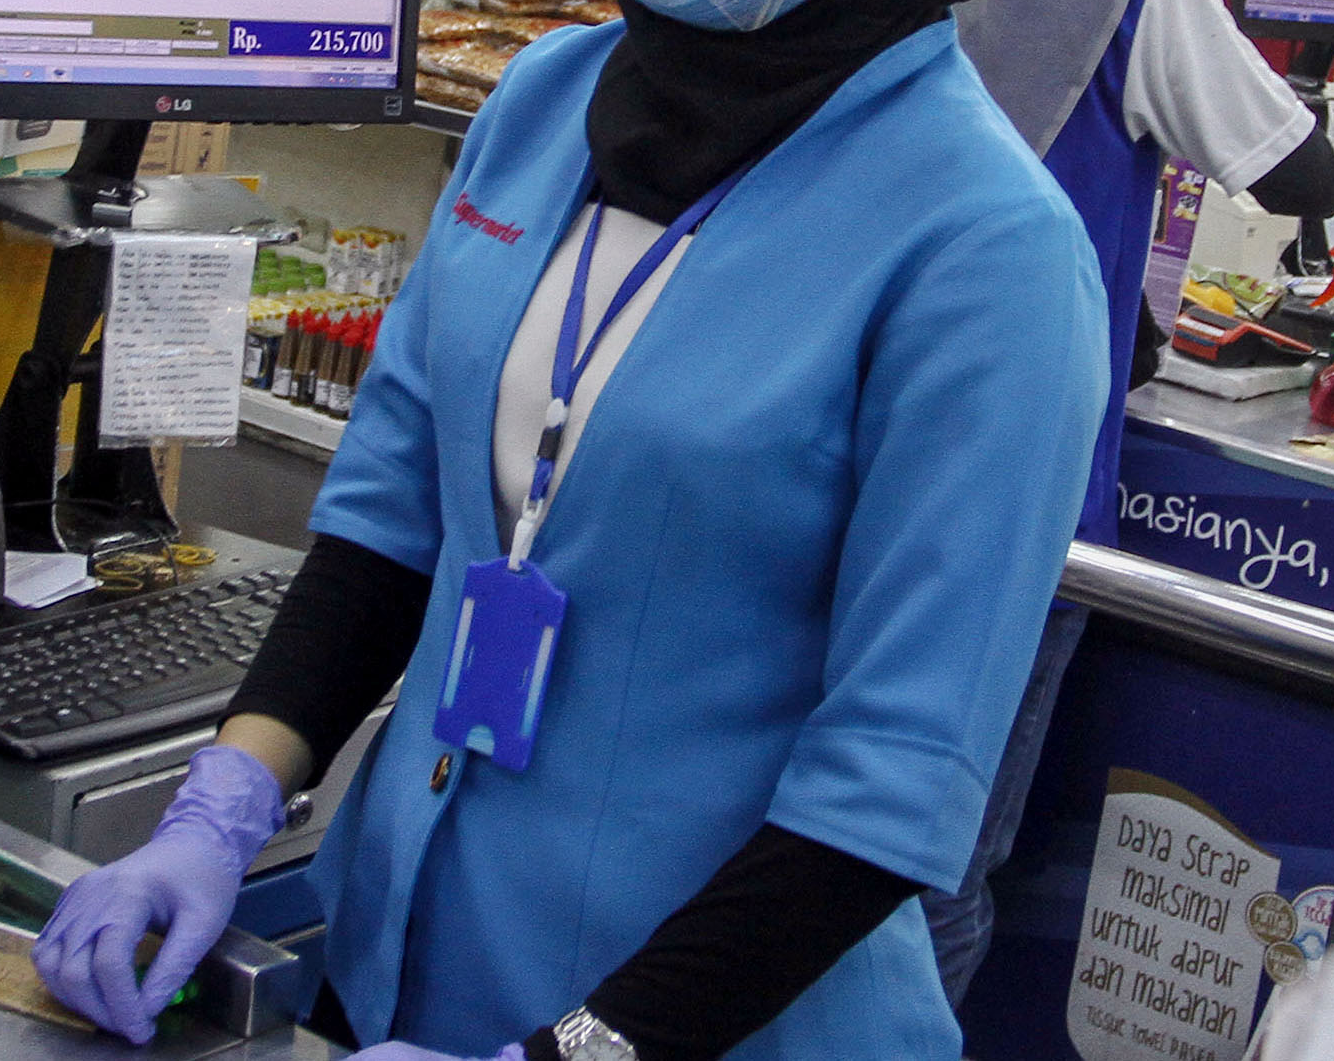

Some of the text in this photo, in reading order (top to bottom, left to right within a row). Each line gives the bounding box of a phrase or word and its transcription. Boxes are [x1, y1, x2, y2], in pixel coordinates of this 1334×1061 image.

[233, 26, 262, 54] Rp.
[308, 28, 385, 55] 215,700
[174, 97, 192, 111] LG
[1120, 866, 1231, 935] maksimal
[1091, 906, 1163, 962] untuk
[1171, 939, 1244, 988] dapur
[1079, 954, 1237, 1040] dan makanan
